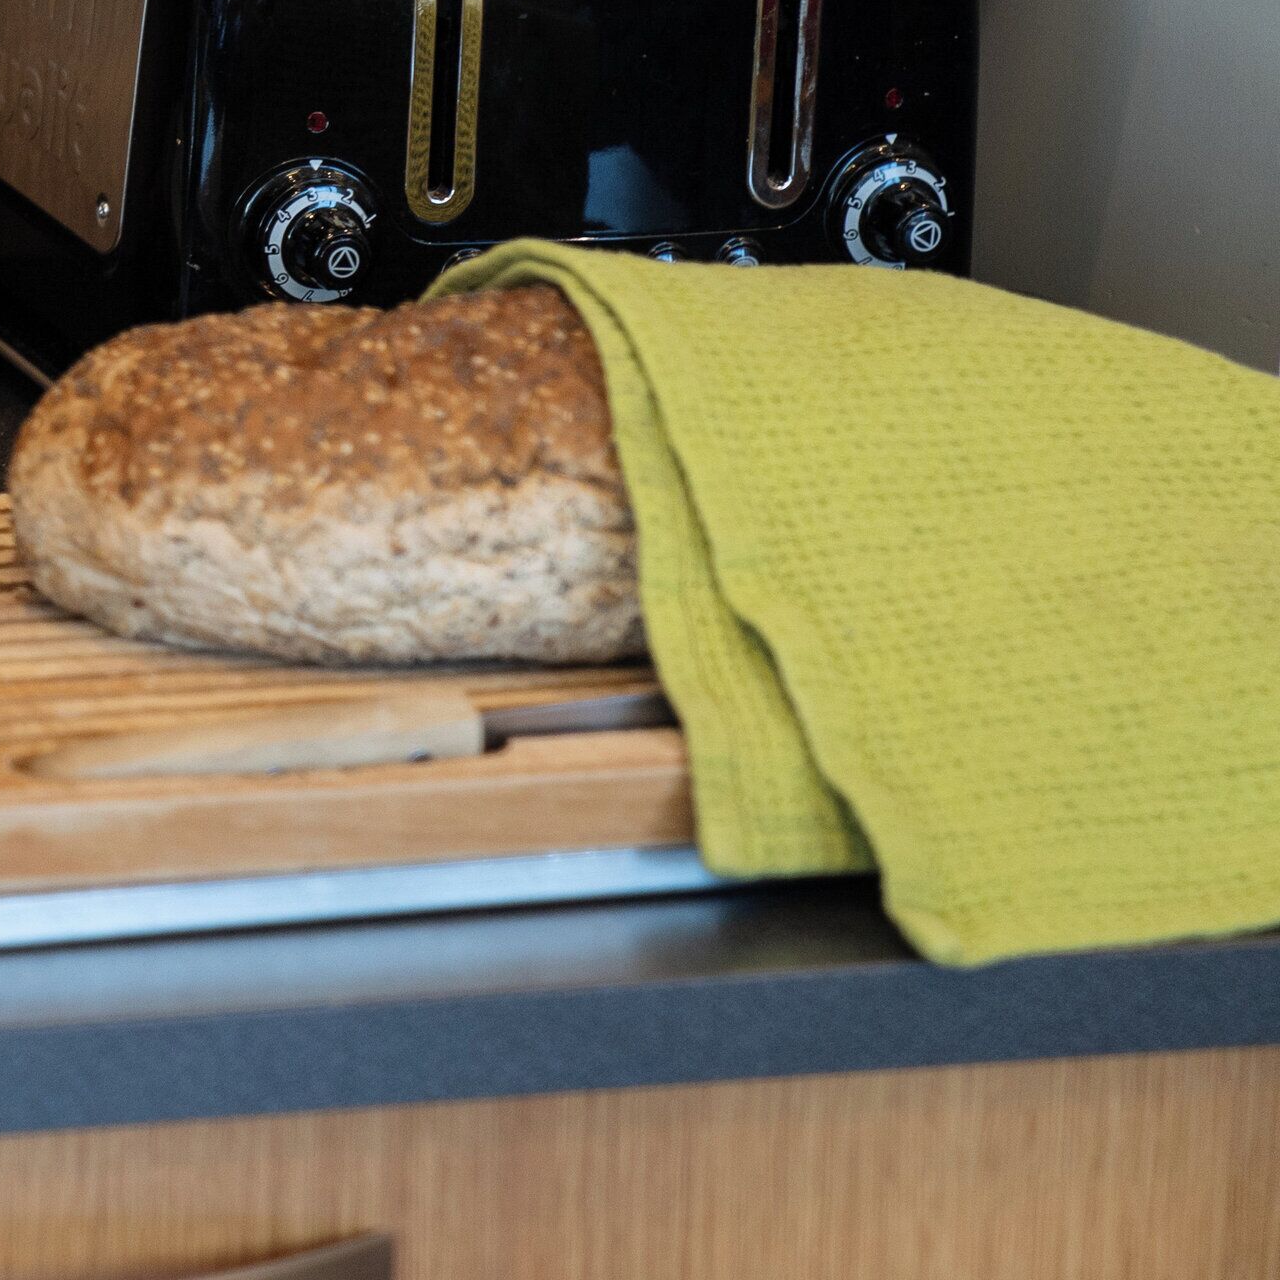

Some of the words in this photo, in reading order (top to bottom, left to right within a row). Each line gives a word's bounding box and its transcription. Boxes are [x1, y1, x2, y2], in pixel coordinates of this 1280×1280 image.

[906, 160, 917, 174] 3
[873, 170, 885, 182] 4
[934, 177, 947, 193] 2
[306, 187, 318, 201] 3
[341, 188, 354, 204] 2
[848, 197, 862, 209] 5
[277, 209, 291, 223] 4
[843, 229, 858, 241] 6
[264, 244, 280, 255] 5
[274, 273, 289, 285] 6
